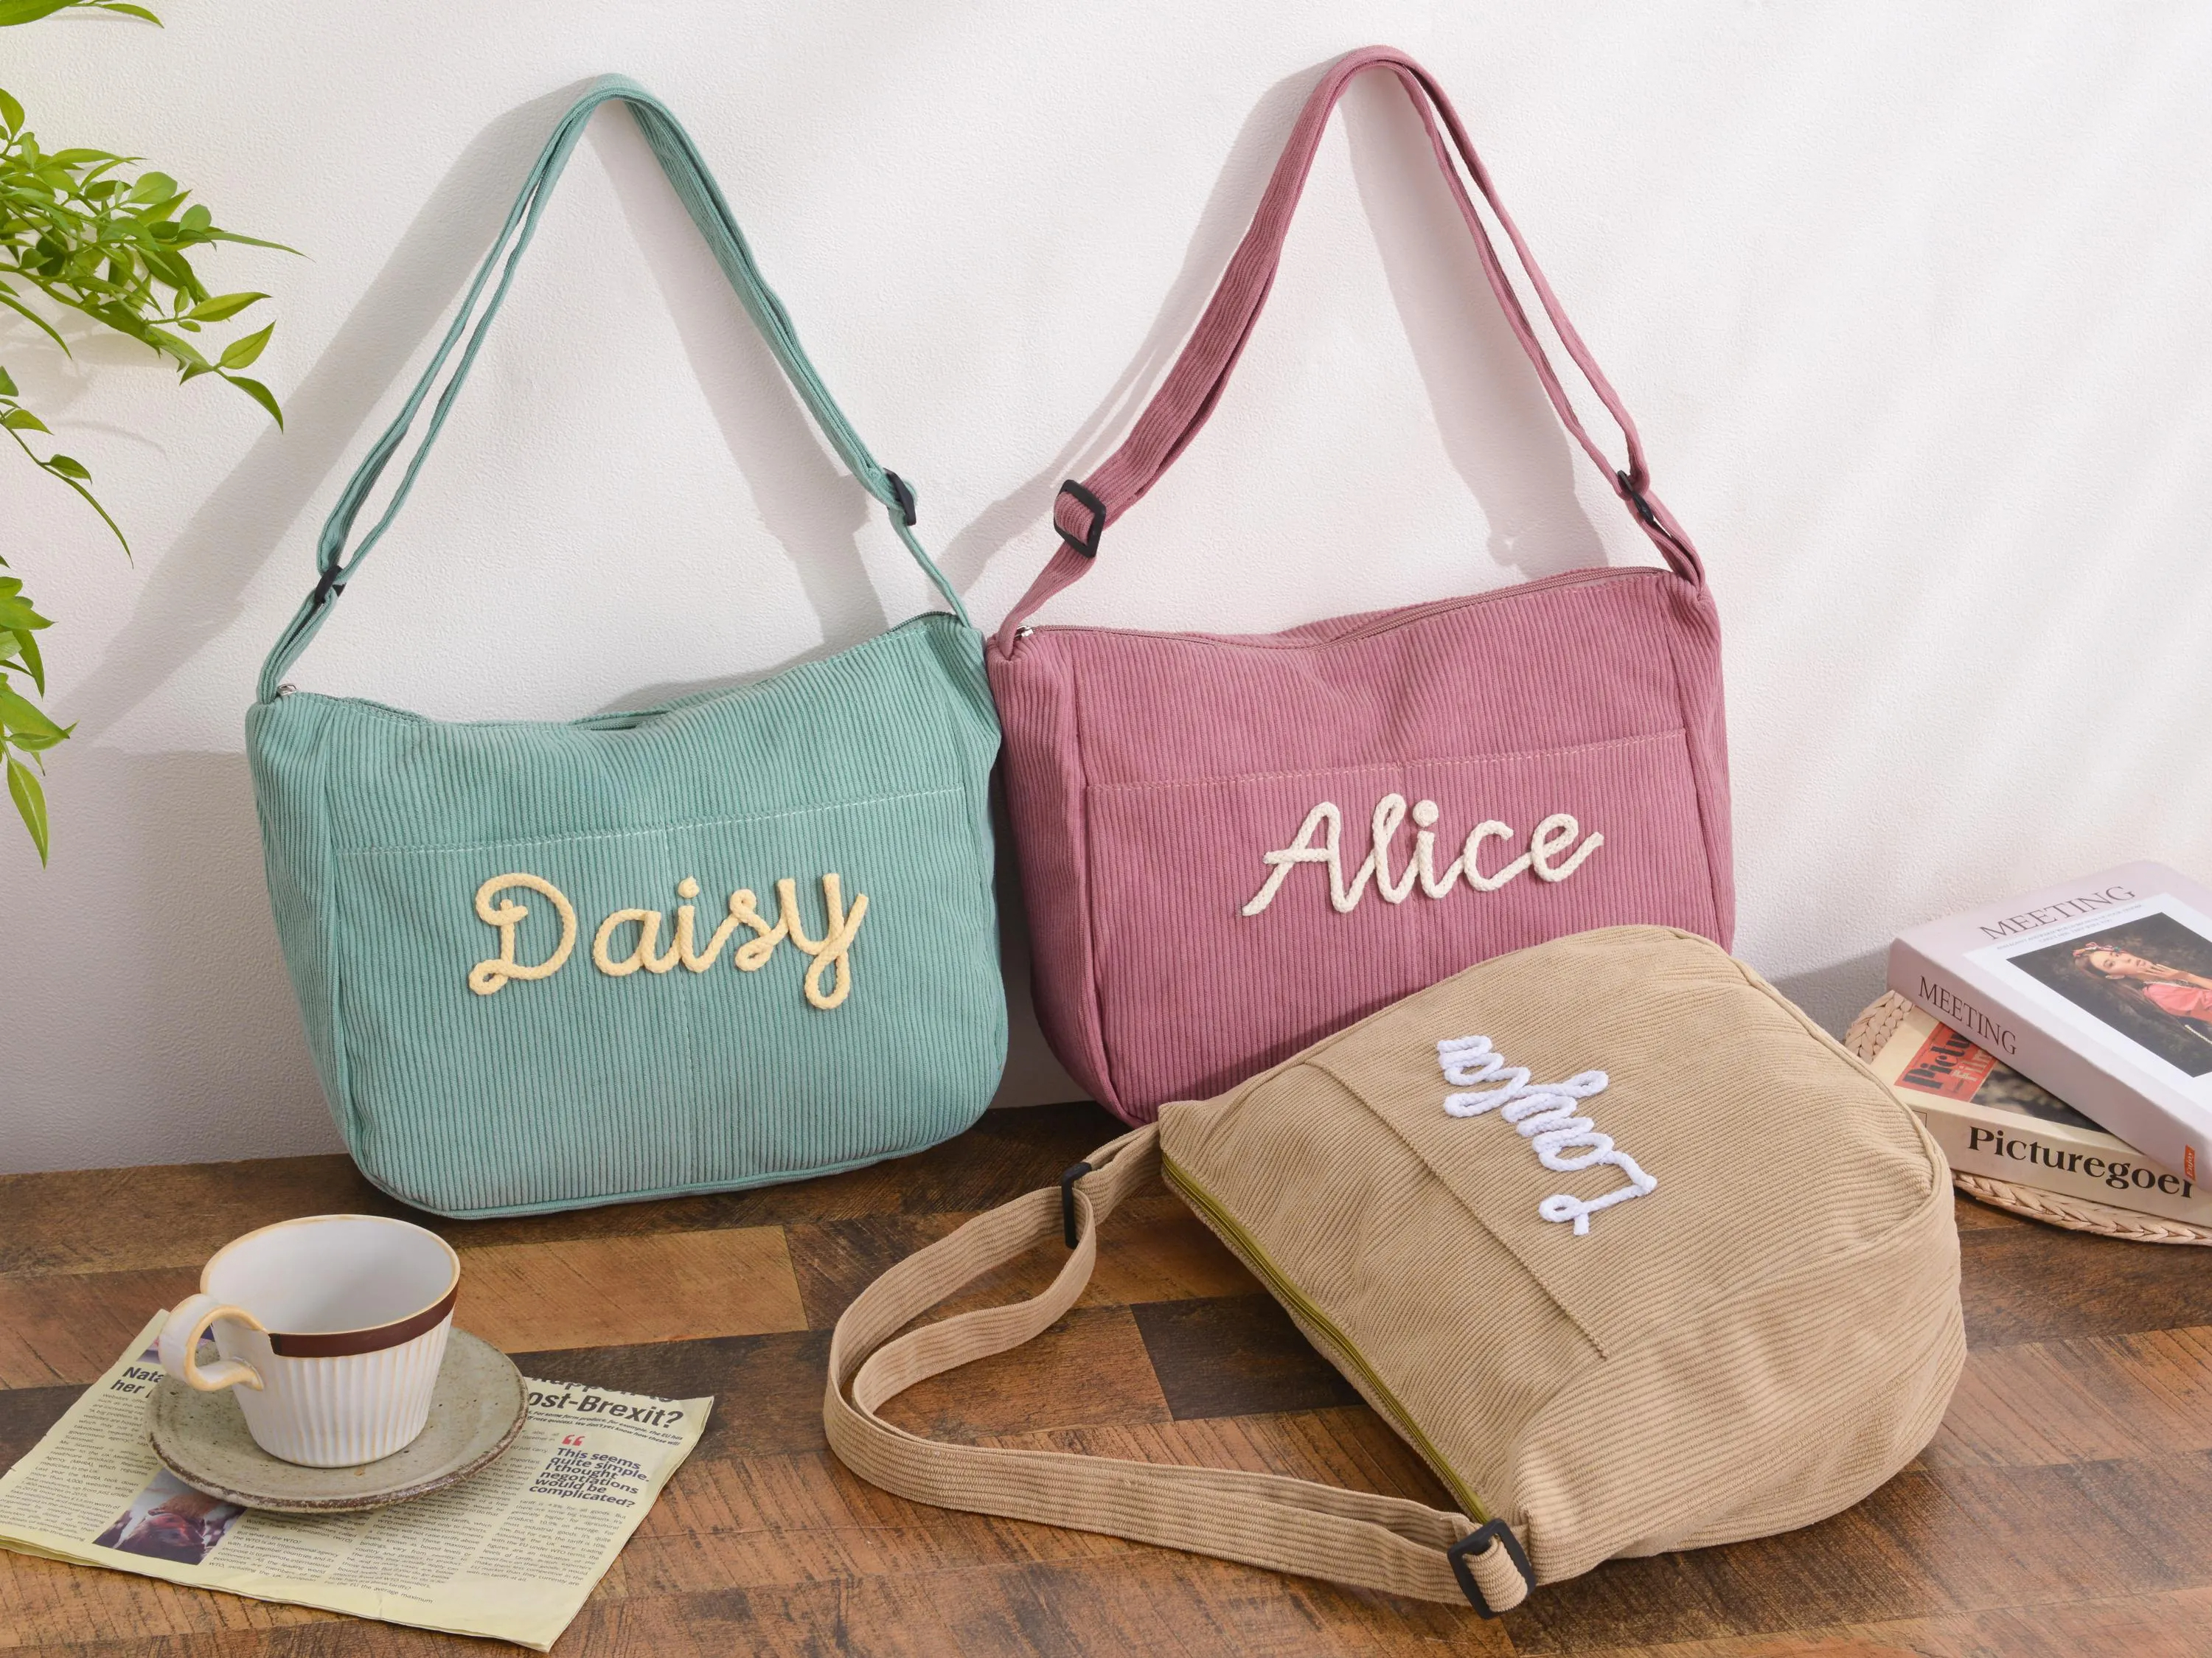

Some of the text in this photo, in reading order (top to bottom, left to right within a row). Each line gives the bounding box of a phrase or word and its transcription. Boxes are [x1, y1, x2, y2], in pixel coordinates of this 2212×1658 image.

[1242, 793, 1604, 916] Alice
[1979, 886, 2136, 940] MEETING
[469, 873, 869, 1010] Daisy
[1918, 975, 2018, 1056] MEETING
[1437, 1035, 1658, 1236] Layla
[111, 1379, 145, 1393] her
[550, 1457, 650, 1482] quite simple.
[557, 1448, 641, 1469] This seems
[539, 1471, 639, 1494] negotiations
[557, 1464, 618, 1480] thought
[529, 1486, 636, 1508] complicated?
[535, 1479, 607, 1493] would be
